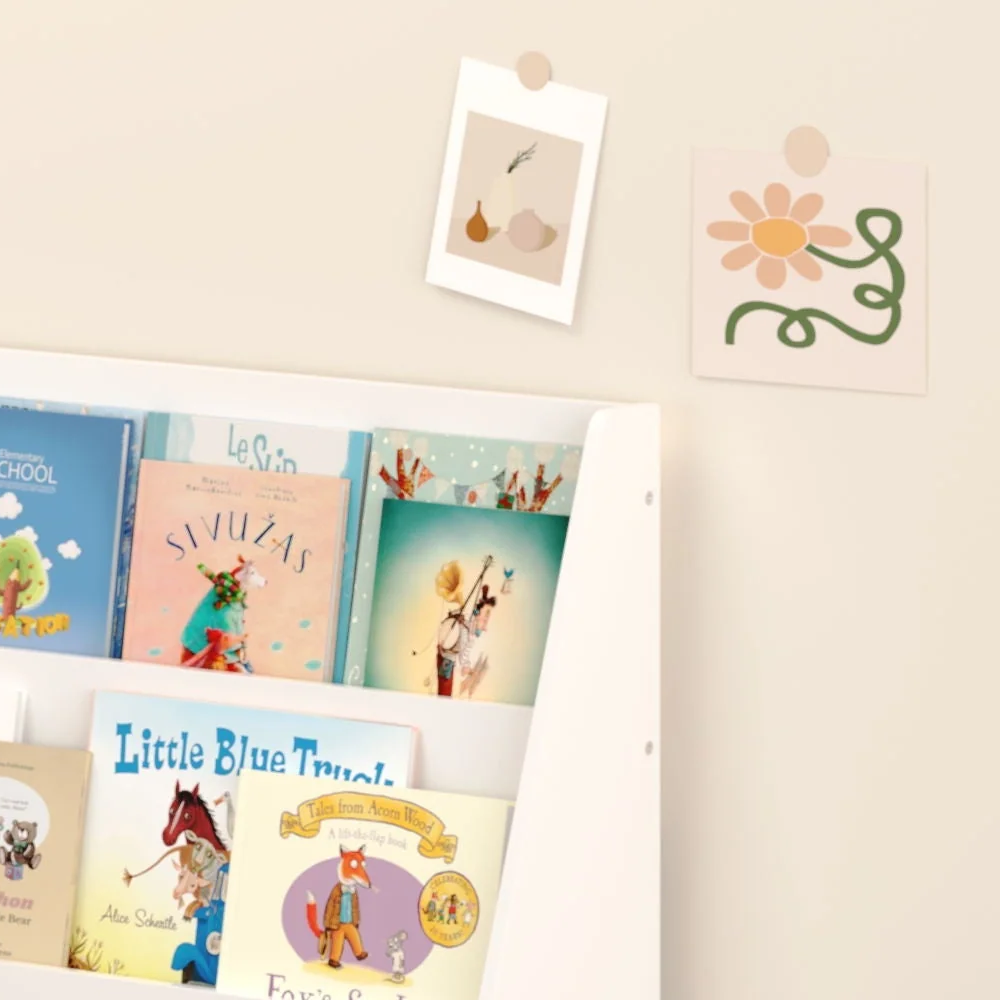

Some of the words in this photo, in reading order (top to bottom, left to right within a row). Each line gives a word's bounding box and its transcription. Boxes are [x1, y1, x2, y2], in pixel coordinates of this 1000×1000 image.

[227, 423, 248, 464] Le
[114, 722, 205, 775] Little
[213, 727, 286, 776] Blue
[307, 802, 335, 819] Tales
[338, 798, 364, 815] from
[367, 799, 401, 821] Acorn
[404, 806, 436, 835] Wood
[338, 827, 386, 846] lift-the-flap
[387, 835, 408, 850] book
[8, 913, 32, 926] Bear
[99, 903, 131, 924] Alice
